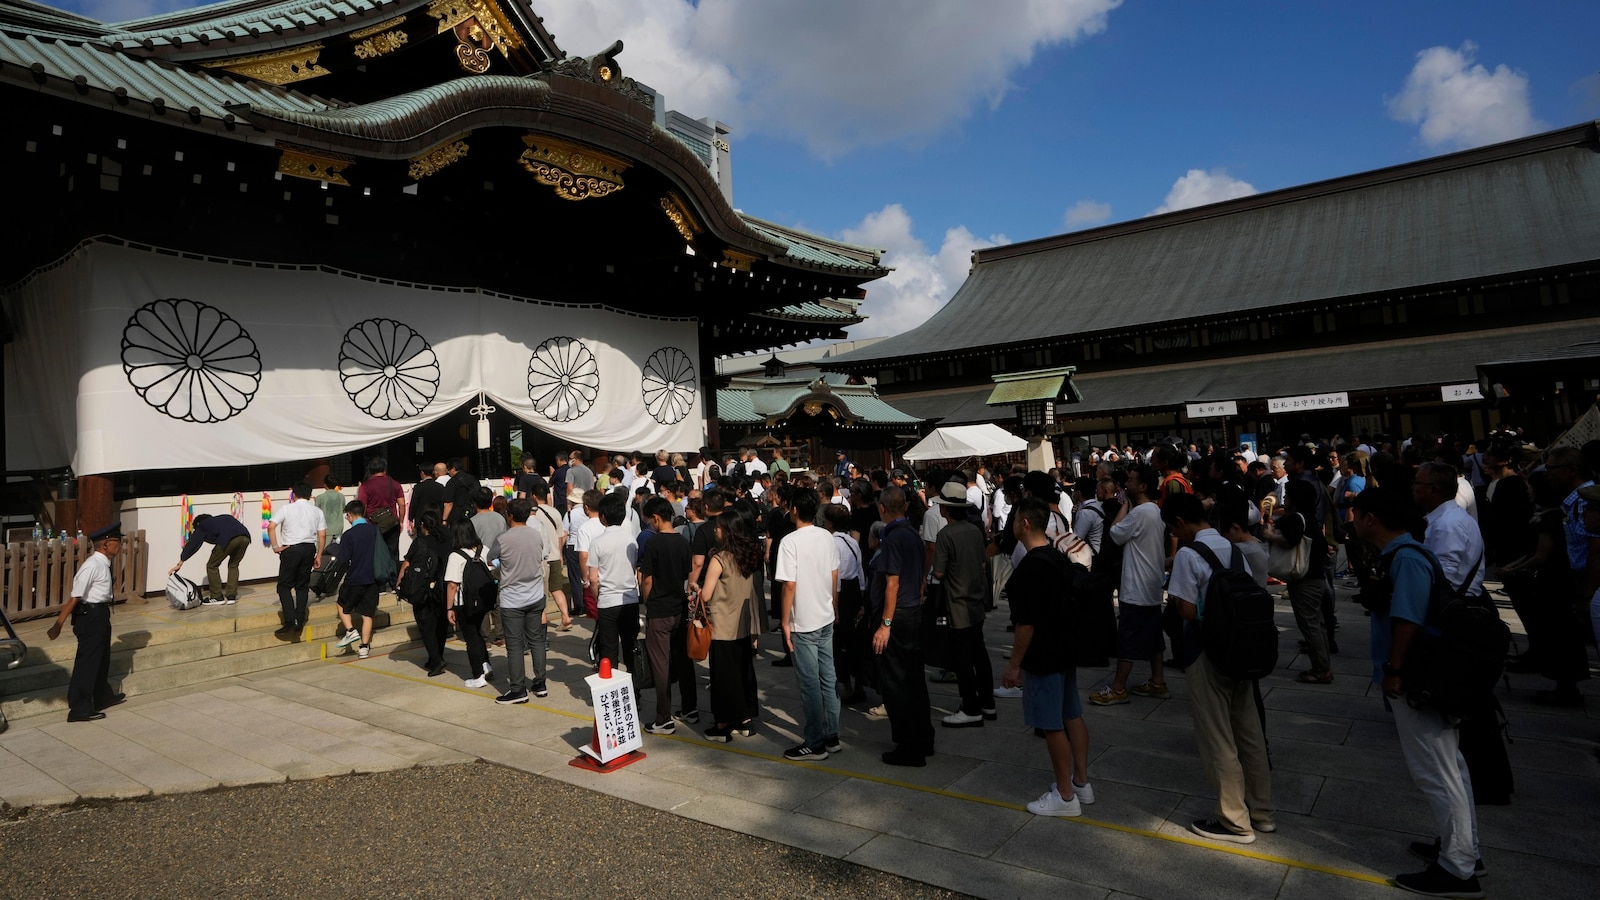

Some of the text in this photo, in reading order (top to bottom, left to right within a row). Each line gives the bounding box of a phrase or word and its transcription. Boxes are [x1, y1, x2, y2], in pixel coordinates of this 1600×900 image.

[610, 689, 627, 746] 列後方にお並
